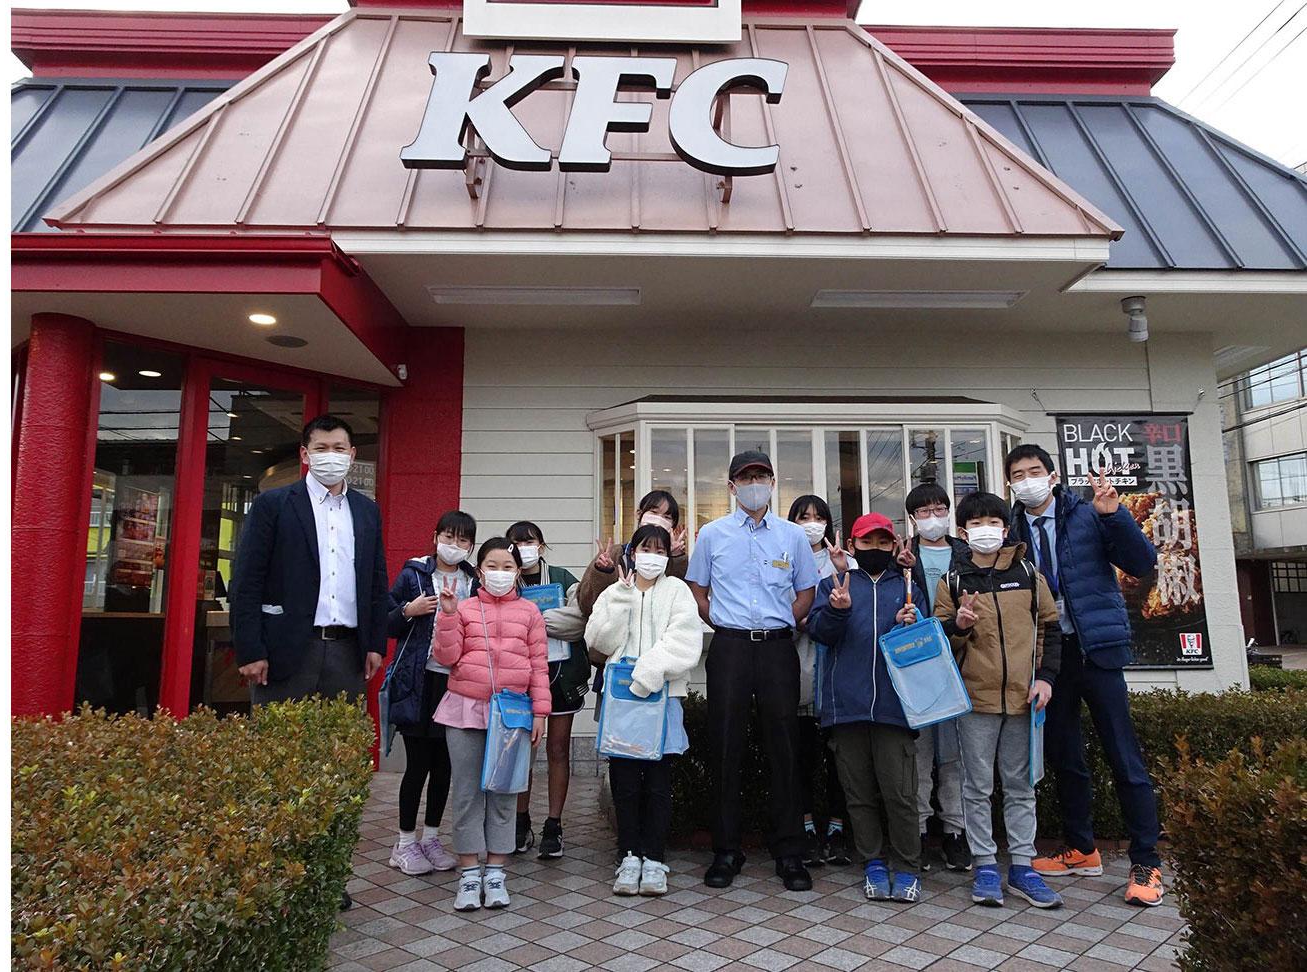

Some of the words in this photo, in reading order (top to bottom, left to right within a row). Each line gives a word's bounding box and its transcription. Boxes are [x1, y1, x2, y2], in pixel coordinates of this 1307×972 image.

[400, 51, 789, 176] KFC
[1063, 423, 1133, 442] BLACK
[1143, 423, 1183, 444] 辛口
[1065, 442, 1135, 476] HOT
